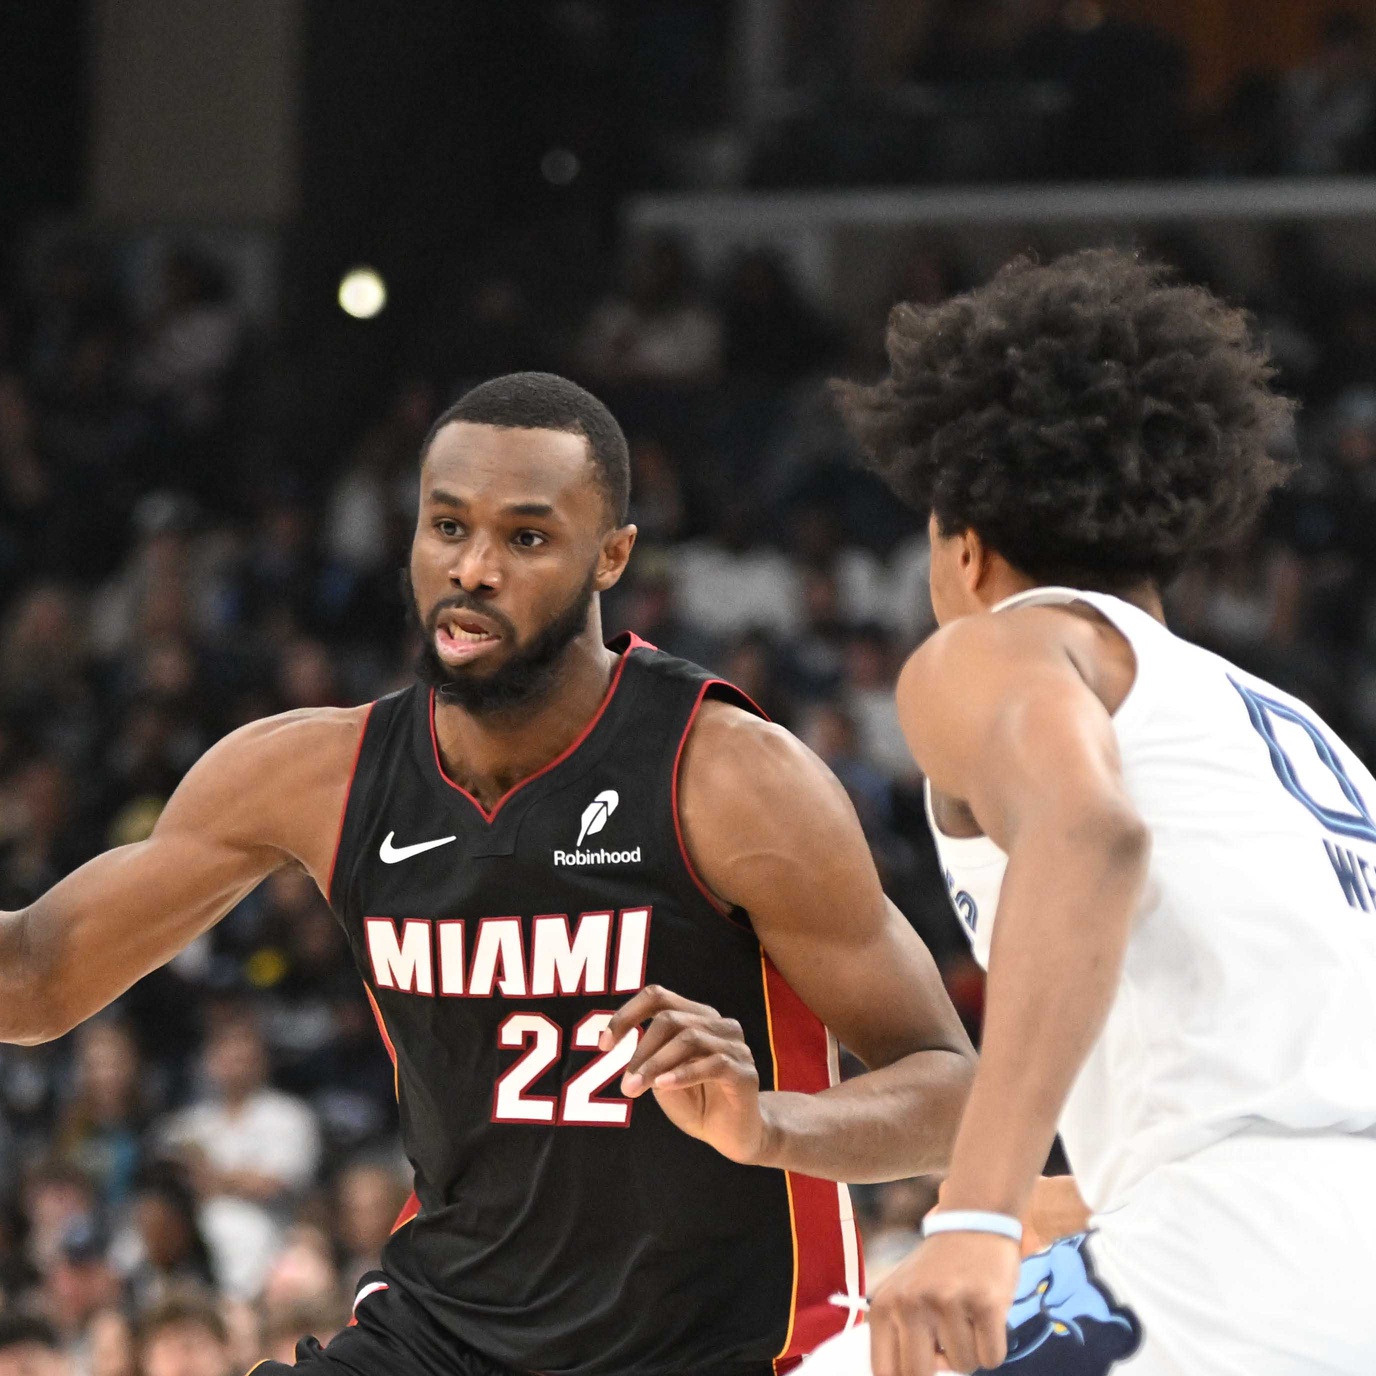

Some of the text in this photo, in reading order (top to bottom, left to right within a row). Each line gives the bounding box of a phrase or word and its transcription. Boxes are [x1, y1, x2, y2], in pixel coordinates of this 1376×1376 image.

[553, 846, 641, 866] Robinhood
[363, 905, 652, 998] MIAMI
[490, 1009, 644, 1128] 22
